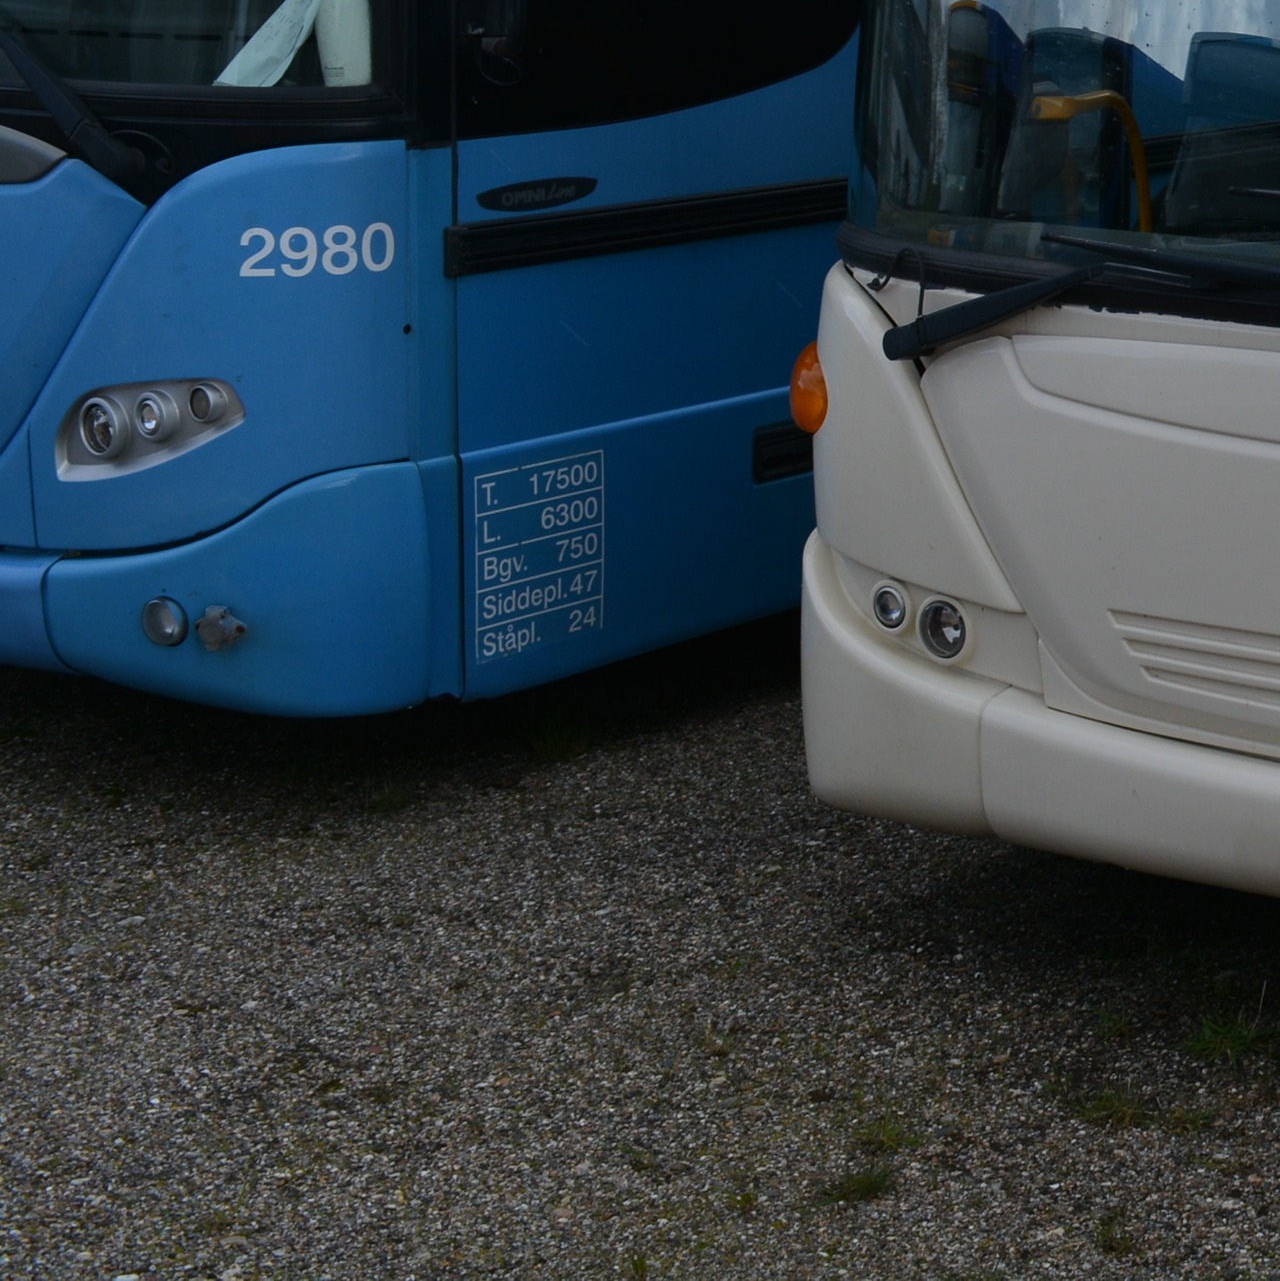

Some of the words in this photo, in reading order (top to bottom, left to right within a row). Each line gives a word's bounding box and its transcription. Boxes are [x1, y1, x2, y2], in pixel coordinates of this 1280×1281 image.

[239, 222, 395, 278] 2980
[481, 482, 498, 506] T.
[529, 461, 597, 495] 17500
[483, 521, 501, 544] L.
[541, 497, 598, 530] 6300
[483, 555, 528, 583] Bgv.
[555, 532, 598, 562] 750
[482, 577, 567, 619] Siddepl.
[569, 570, 598, 595] 47
[482, 621, 541, 657] Ståpl.
[568, 606, 596, 633] 24
